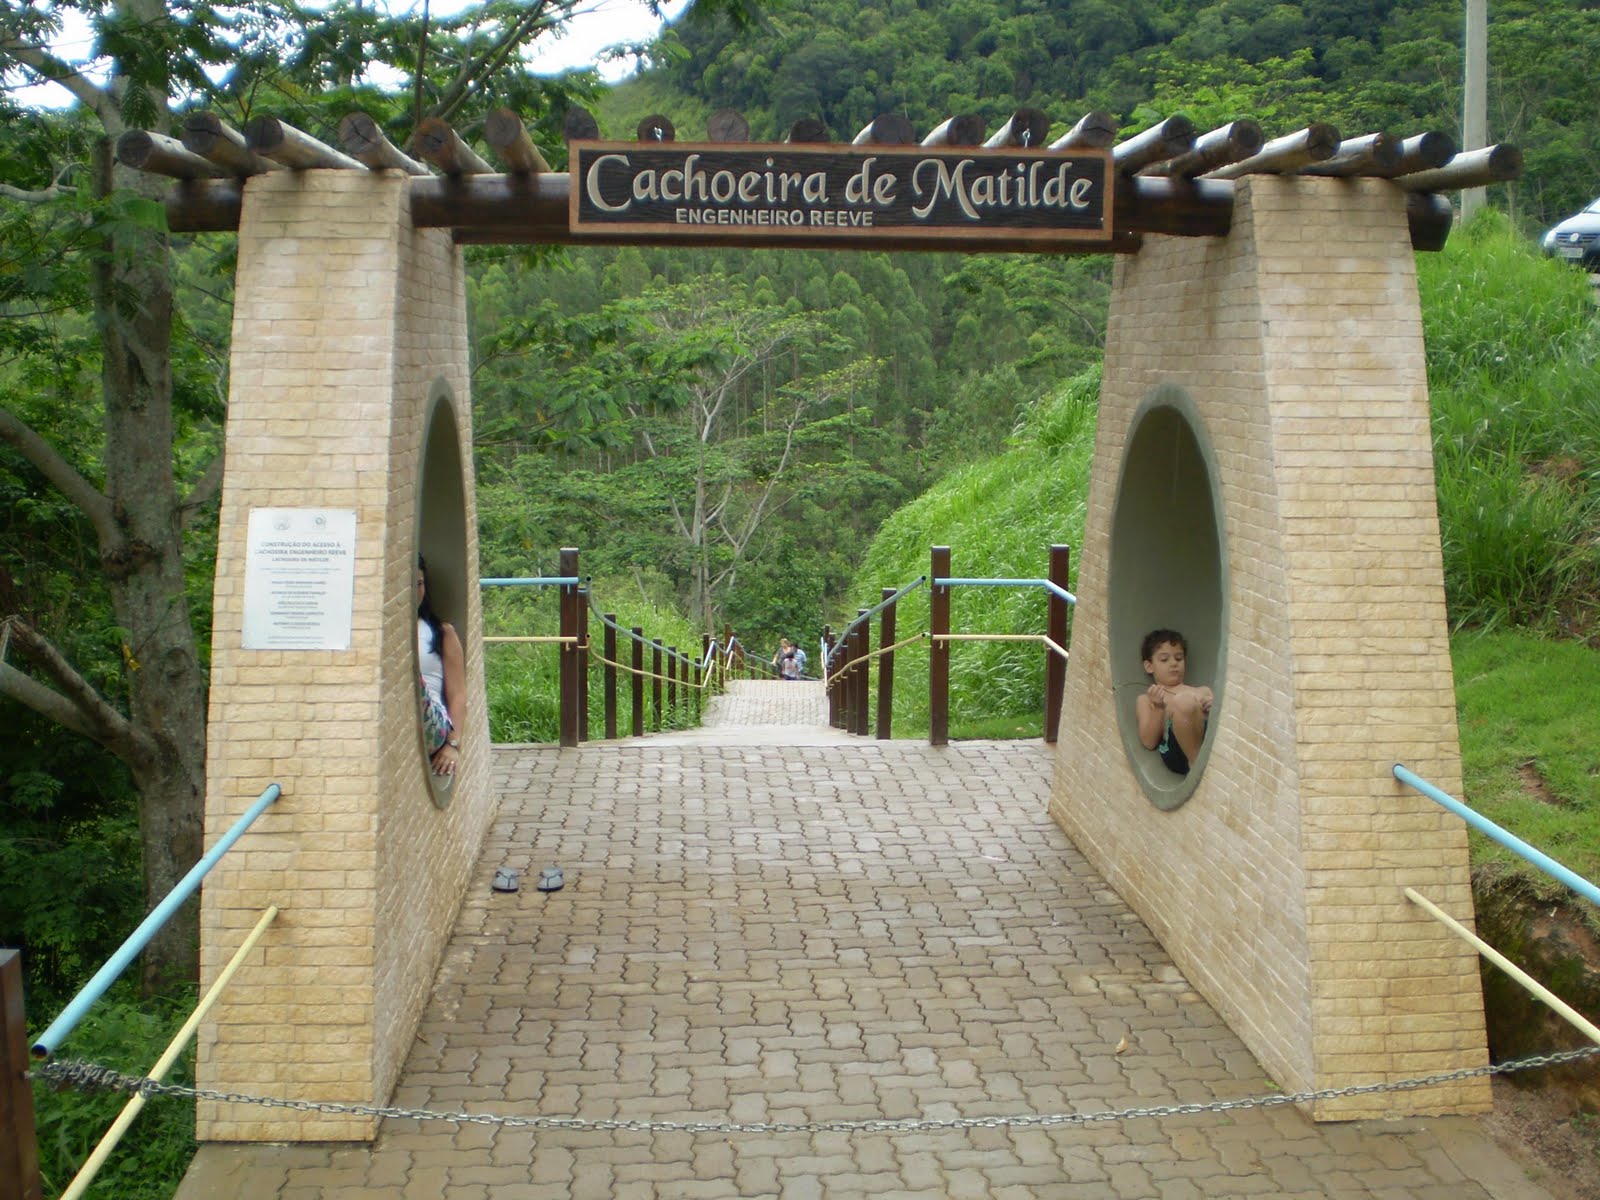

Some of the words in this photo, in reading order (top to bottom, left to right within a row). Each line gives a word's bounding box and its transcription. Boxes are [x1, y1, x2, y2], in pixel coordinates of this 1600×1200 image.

[586, 153, 829, 212] Cachoeira
[845, 157, 898, 206] de
[911, 158, 1093, 219] Matilde
[675, 208, 803, 226] ENGENHEIRO
[810, 209, 873, 227] REEVE
